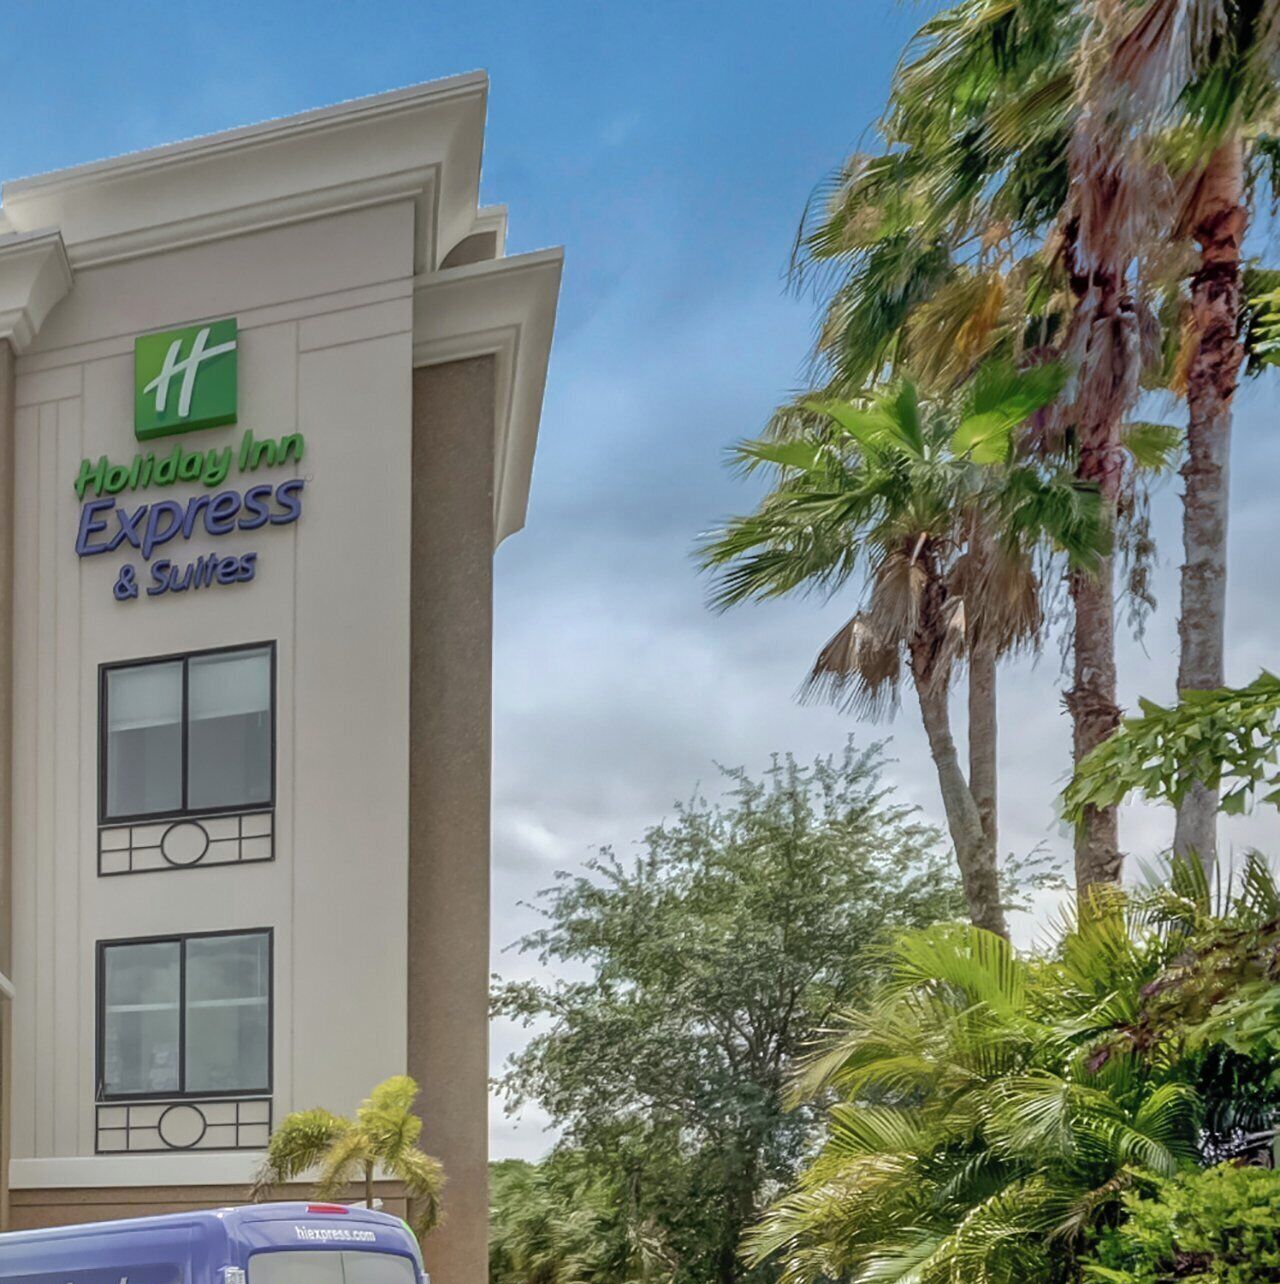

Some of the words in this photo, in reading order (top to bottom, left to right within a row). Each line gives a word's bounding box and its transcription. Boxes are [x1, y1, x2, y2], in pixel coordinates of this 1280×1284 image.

[74, 444, 232, 500] Holiday
[239, 429, 304, 472] Inn
[75, 479, 304, 560] Express
[113, 564, 138, 600] &
[147, 552, 257, 596] Suites
[295, 1225, 376, 1243] hiexpress.com
